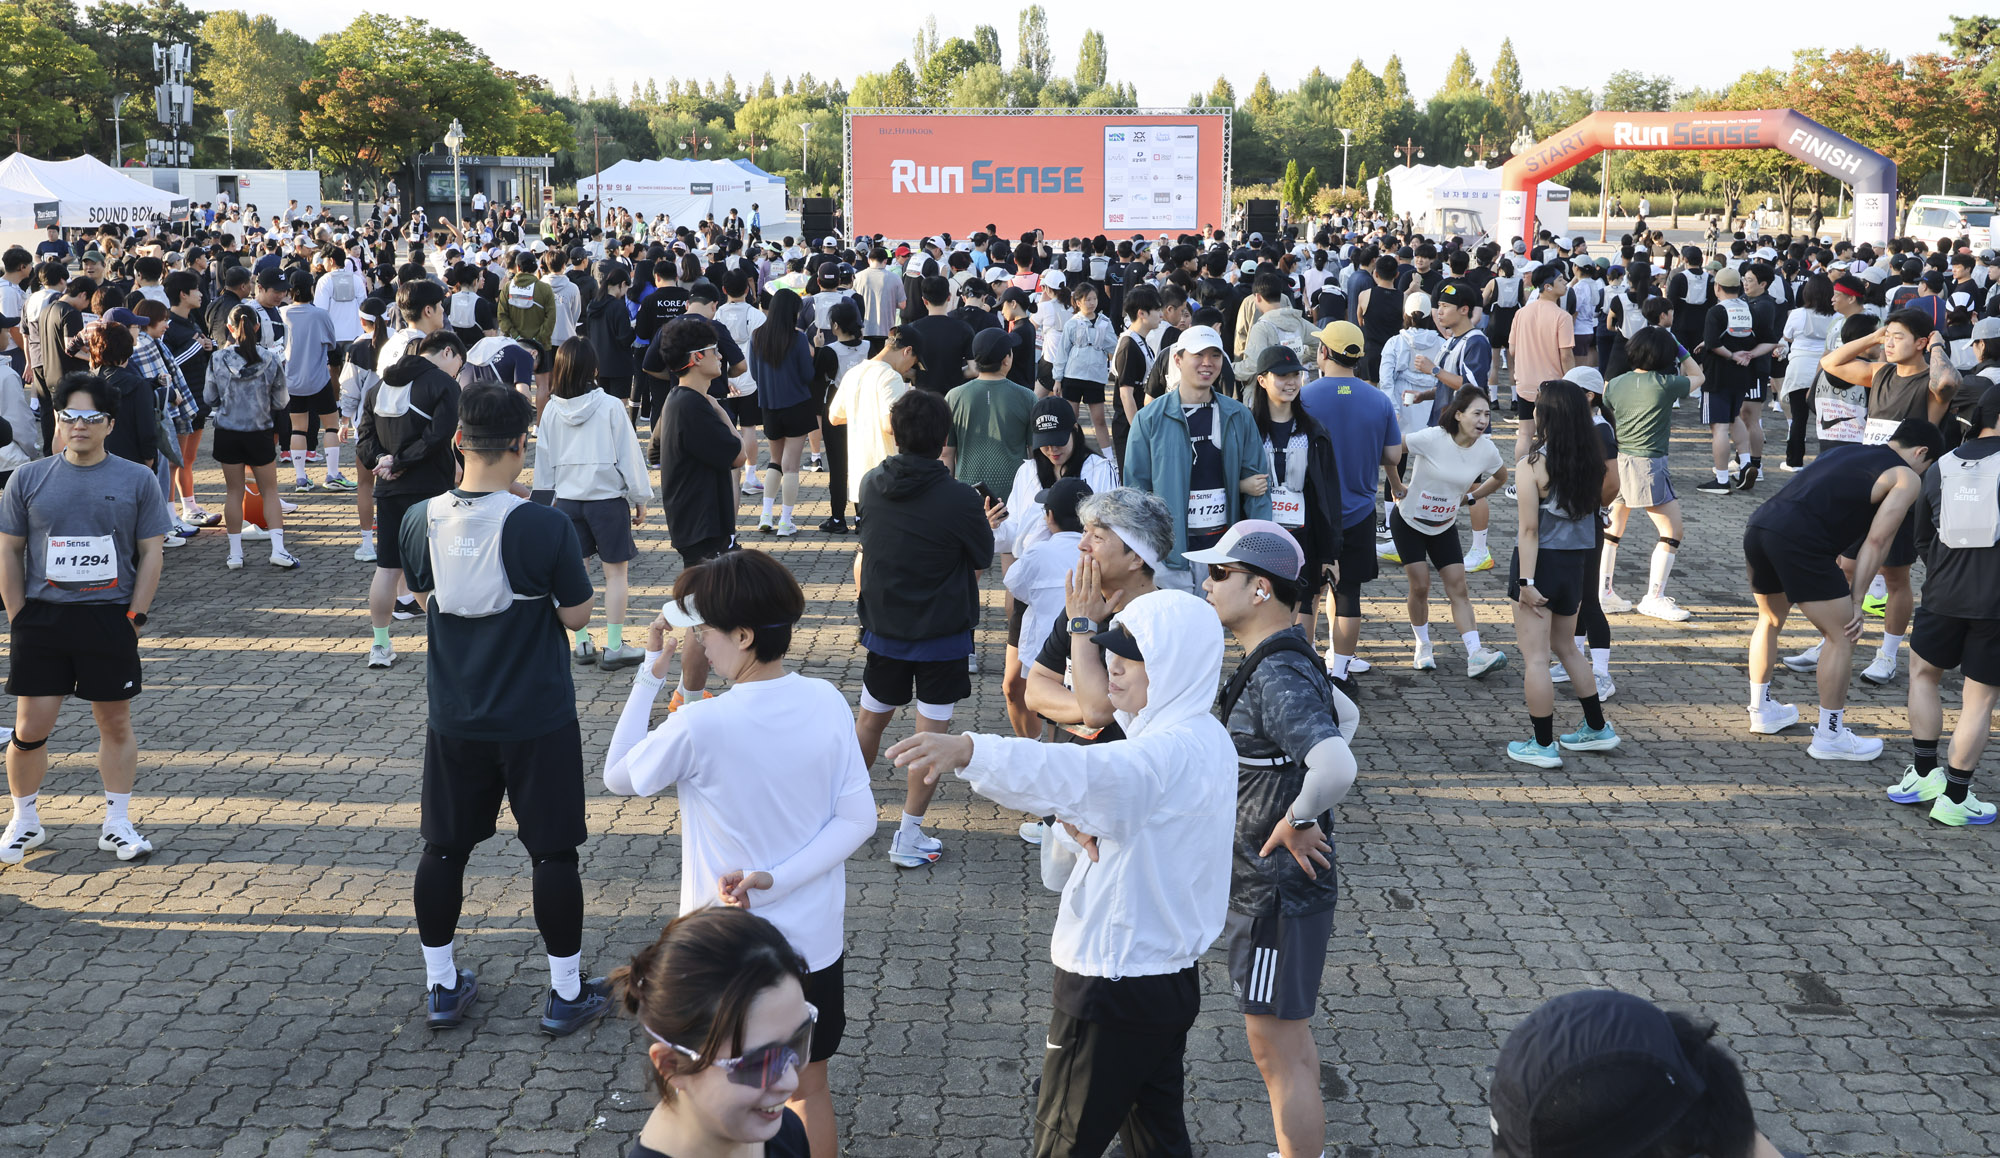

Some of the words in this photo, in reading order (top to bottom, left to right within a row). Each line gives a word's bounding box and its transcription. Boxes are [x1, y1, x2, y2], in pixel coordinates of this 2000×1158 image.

[1524, 130, 1586, 173] START
[1788, 128, 1863, 175] FINISH
[89, 206, 128, 223] SOUND
[132, 206, 152, 222] BOX
[1200, 504, 1225, 515] 1723
[1272, 501, 1299, 512] 2564
[1431, 504, 1456, 513] 2015
[70, 554, 109, 566] 1294
